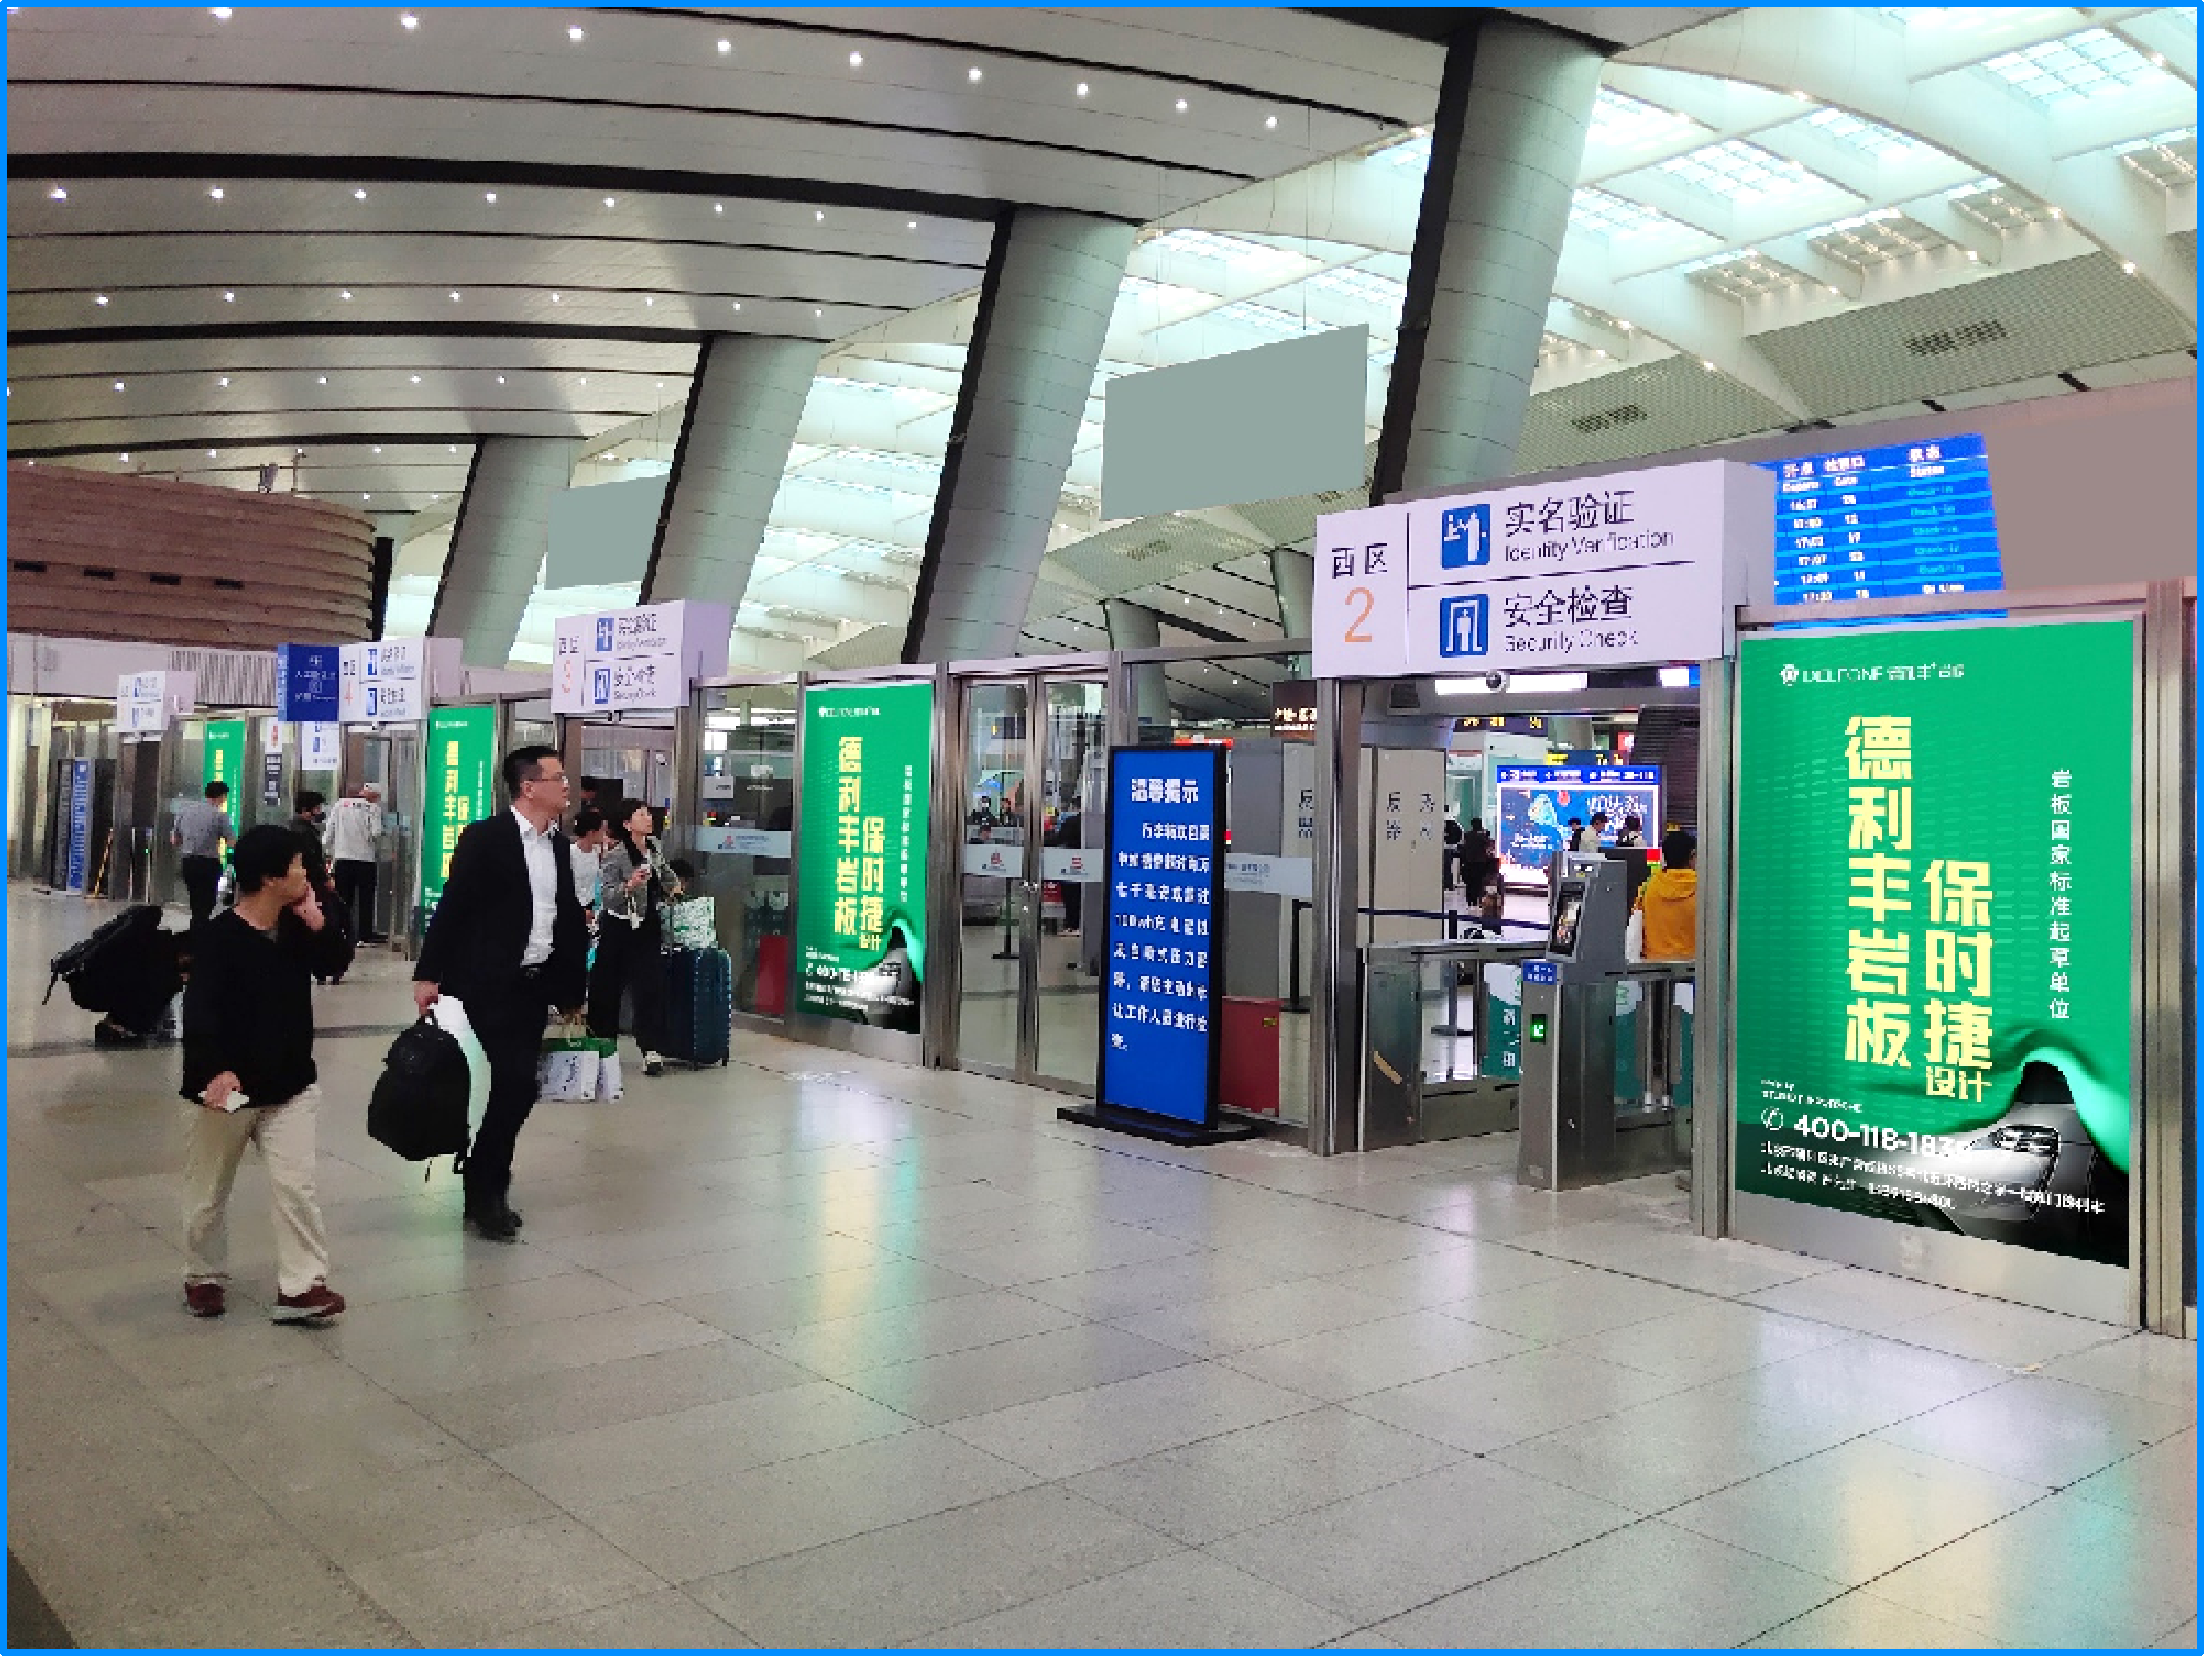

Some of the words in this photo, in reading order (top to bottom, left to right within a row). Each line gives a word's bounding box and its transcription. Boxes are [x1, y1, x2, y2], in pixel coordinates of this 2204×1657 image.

[1505, 490, 1635, 538] 实名验证
[1331, 542, 1388, 579] 西区
[1505, 538, 1569, 564] Identity
[1572, 528, 1674, 555] Verification
[1344, 587, 1375, 643] 2
[1504, 585, 1635, 628] 安全检查
[1504, 632, 1574, 655] Security
[1579, 629, 1639, 650] Check
[1845, 715, 1913, 1069] 德利丰岩板
[2049, 769, 2073, 1019] 岩板国家标准起草单位
[1922, 859, 1993, 1068] 保时捷
[1926, 1066, 1993, 1103] 设计
